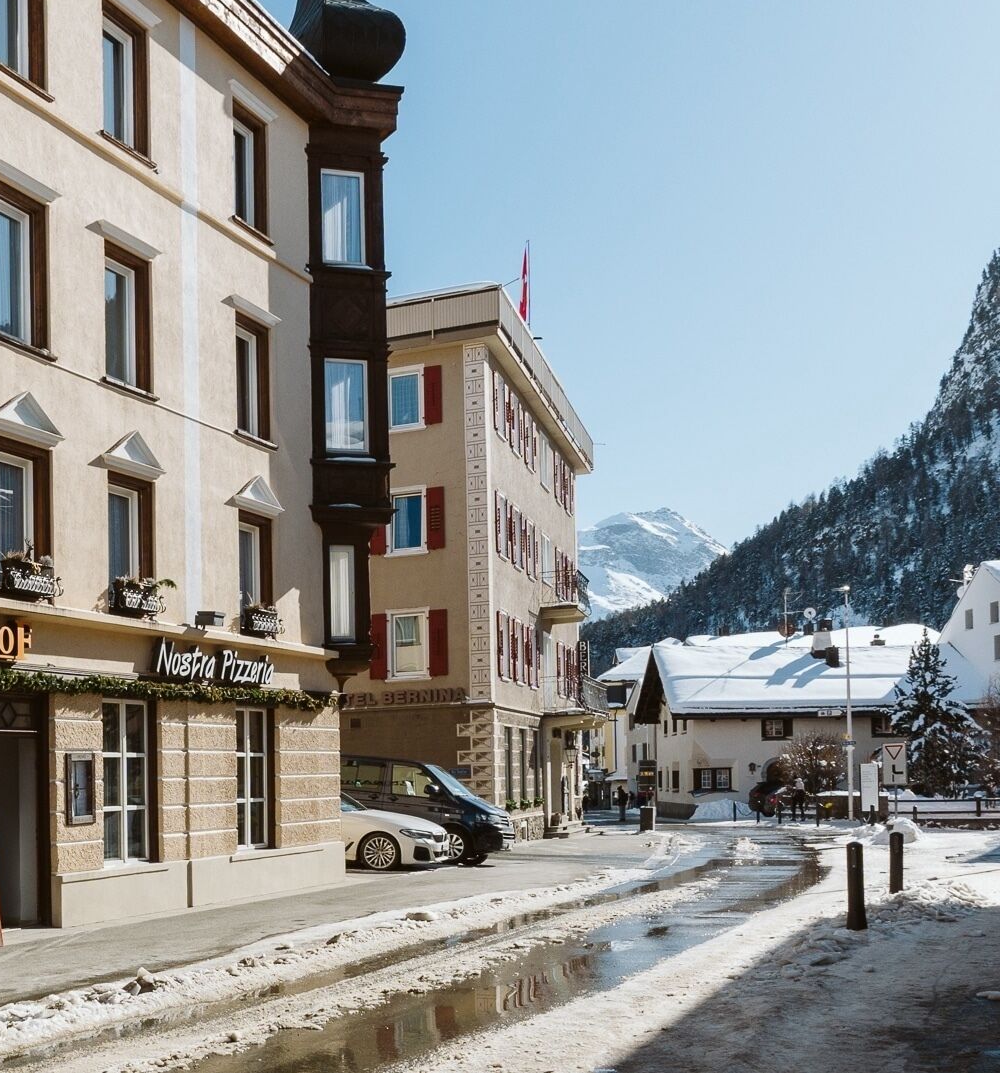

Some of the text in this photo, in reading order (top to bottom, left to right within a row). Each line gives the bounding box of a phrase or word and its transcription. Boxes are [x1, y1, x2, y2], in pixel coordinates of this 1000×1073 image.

[156, 636, 275, 685] Nostra Pizzeria
[345, 687, 466, 707] TEL BERNINA
